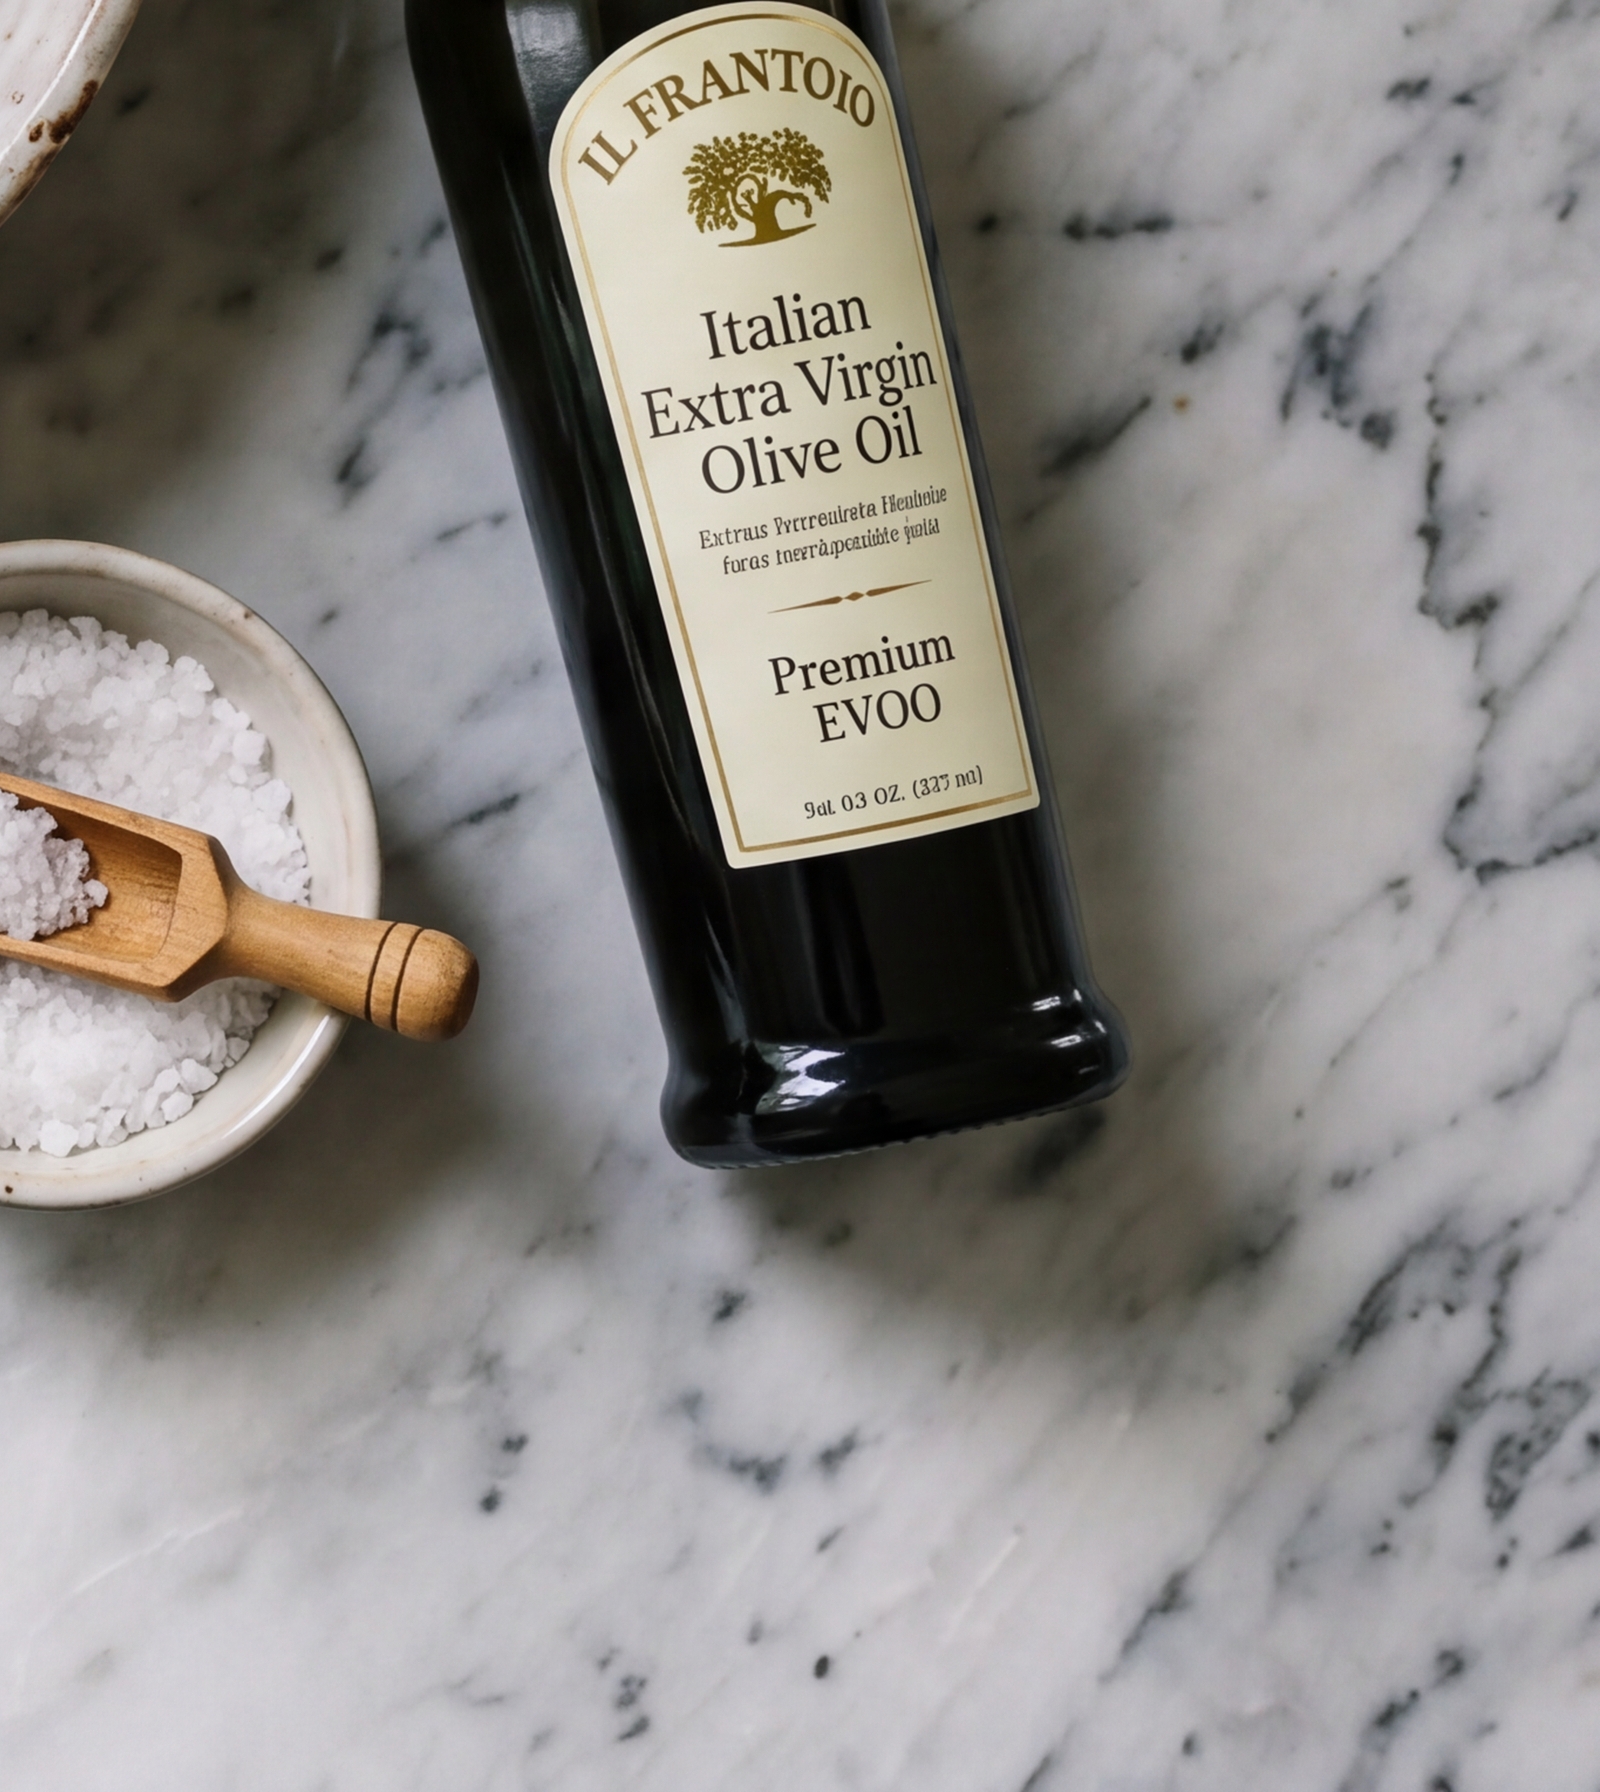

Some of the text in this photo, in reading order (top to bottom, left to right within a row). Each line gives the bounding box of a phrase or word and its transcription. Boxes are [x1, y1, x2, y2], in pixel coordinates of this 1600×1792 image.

[578, 49, 876, 185] IL FRANTOIO
[700, 293, 872, 359] Italian
[641, 341, 938, 438] Extra Virgin
[701, 406, 922, 494] Olive Oil
[768, 633, 955, 696] Premium
[813, 682, 941, 743] EVOO
